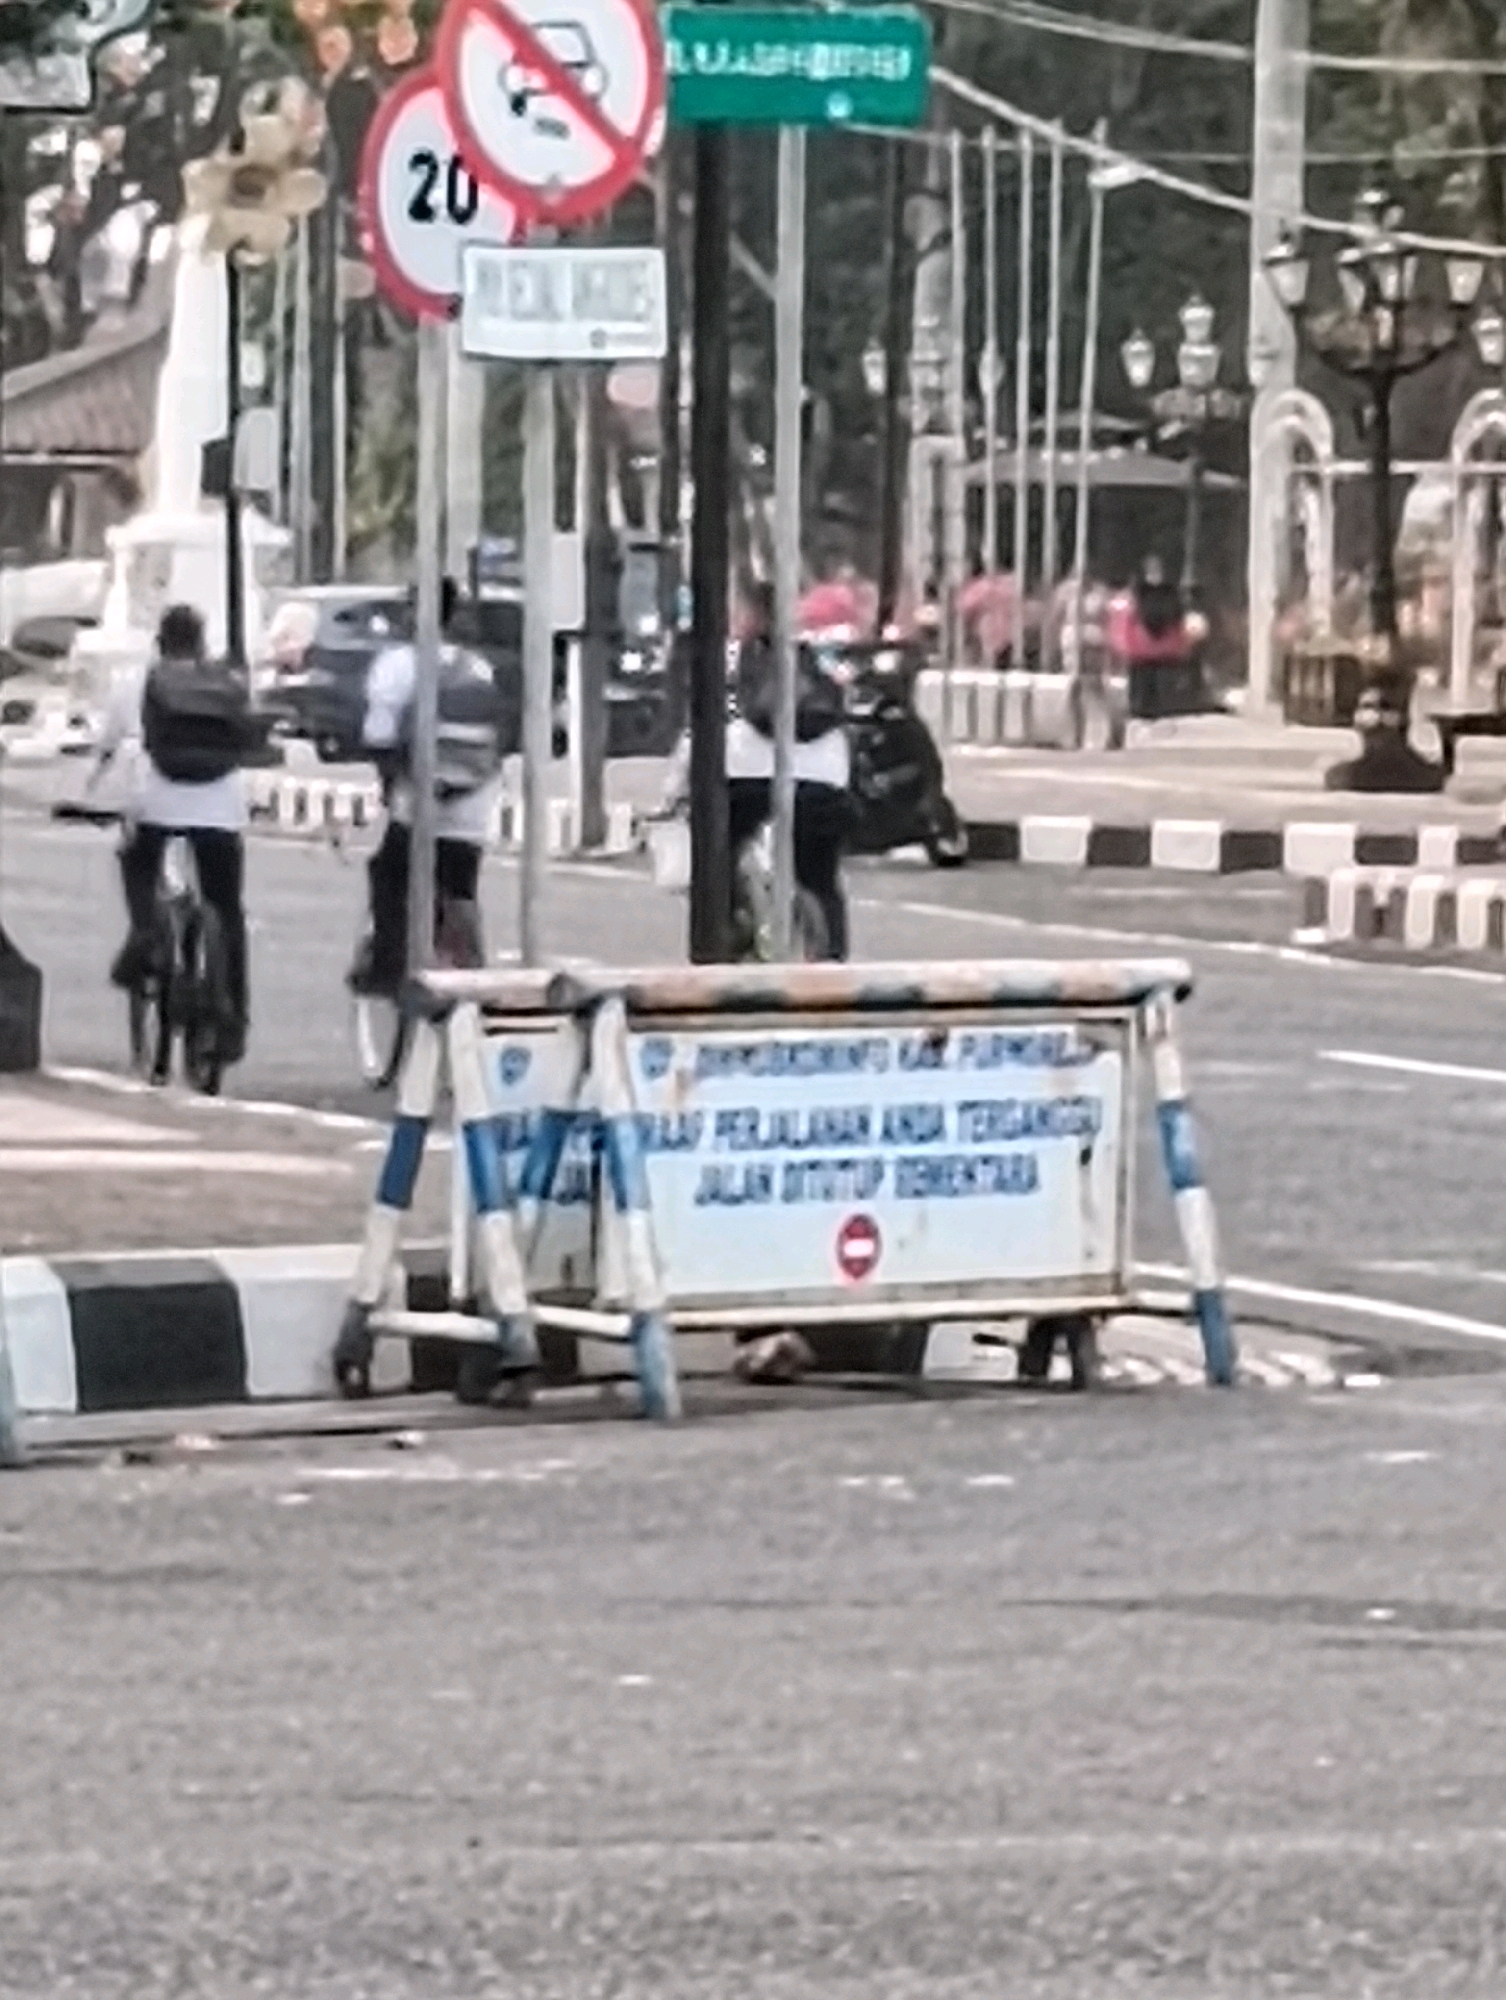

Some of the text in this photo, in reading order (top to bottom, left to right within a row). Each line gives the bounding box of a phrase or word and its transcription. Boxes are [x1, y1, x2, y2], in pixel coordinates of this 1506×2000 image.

[408, 151, 478, 224] 20
[713, 1105, 872, 1151] PERJALANAN
[881, 1102, 946, 1145] ANDA
[955, 1097, 1104, 1142] TERGANGGU
[694, 1153, 1038, 1206] JALAN DITUTUP SEMENTARA
